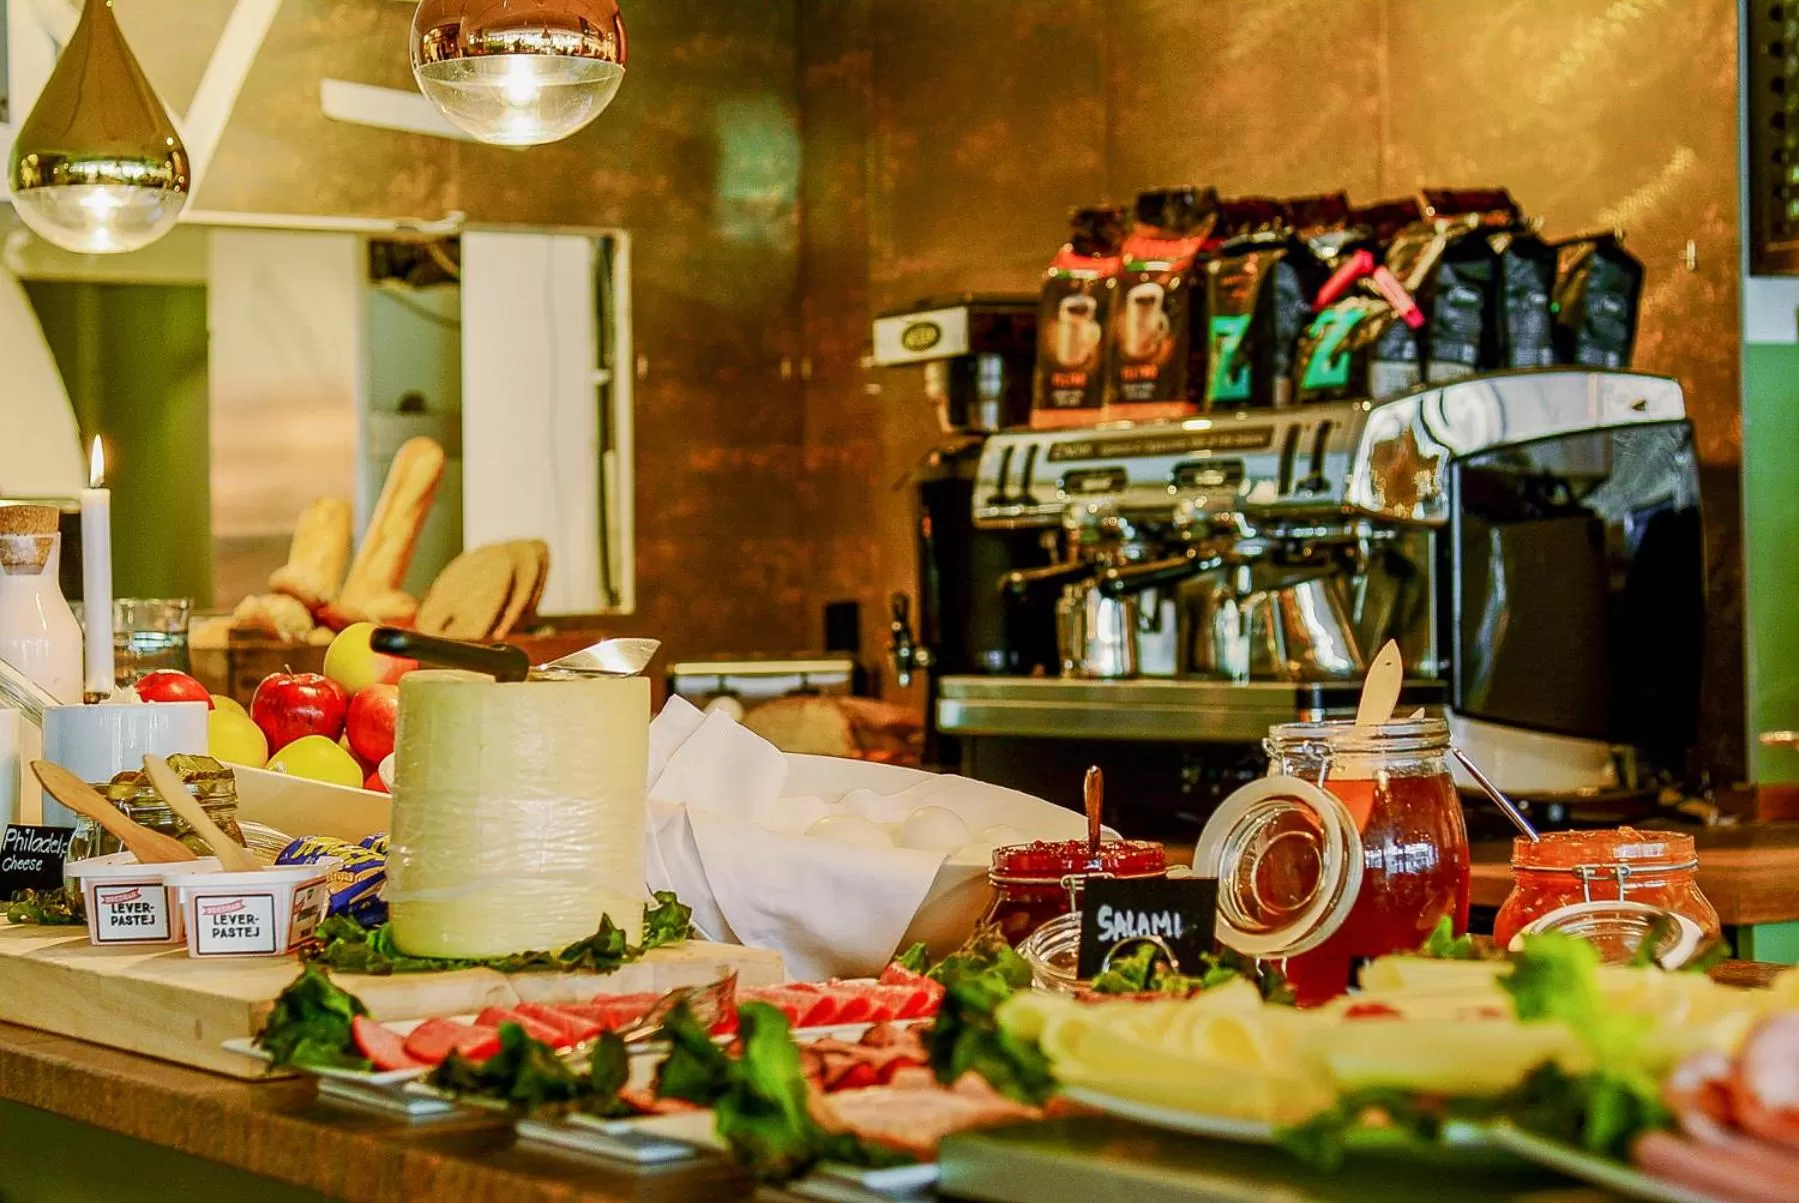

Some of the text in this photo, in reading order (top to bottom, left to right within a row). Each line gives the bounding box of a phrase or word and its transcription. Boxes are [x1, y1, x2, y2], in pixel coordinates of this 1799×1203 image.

[1302, 308, 1367, 388] Z
[1210, 313, 1251, 398] Z
[111, 903, 155, 913] LEVER-
[111, 915, 155, 926] PASTEJ
[213, 914, 259, 925] LEVER-
[1097, 904, 1184, 942] SALAMI
[212, 927, 259, 938] PASTEJ
